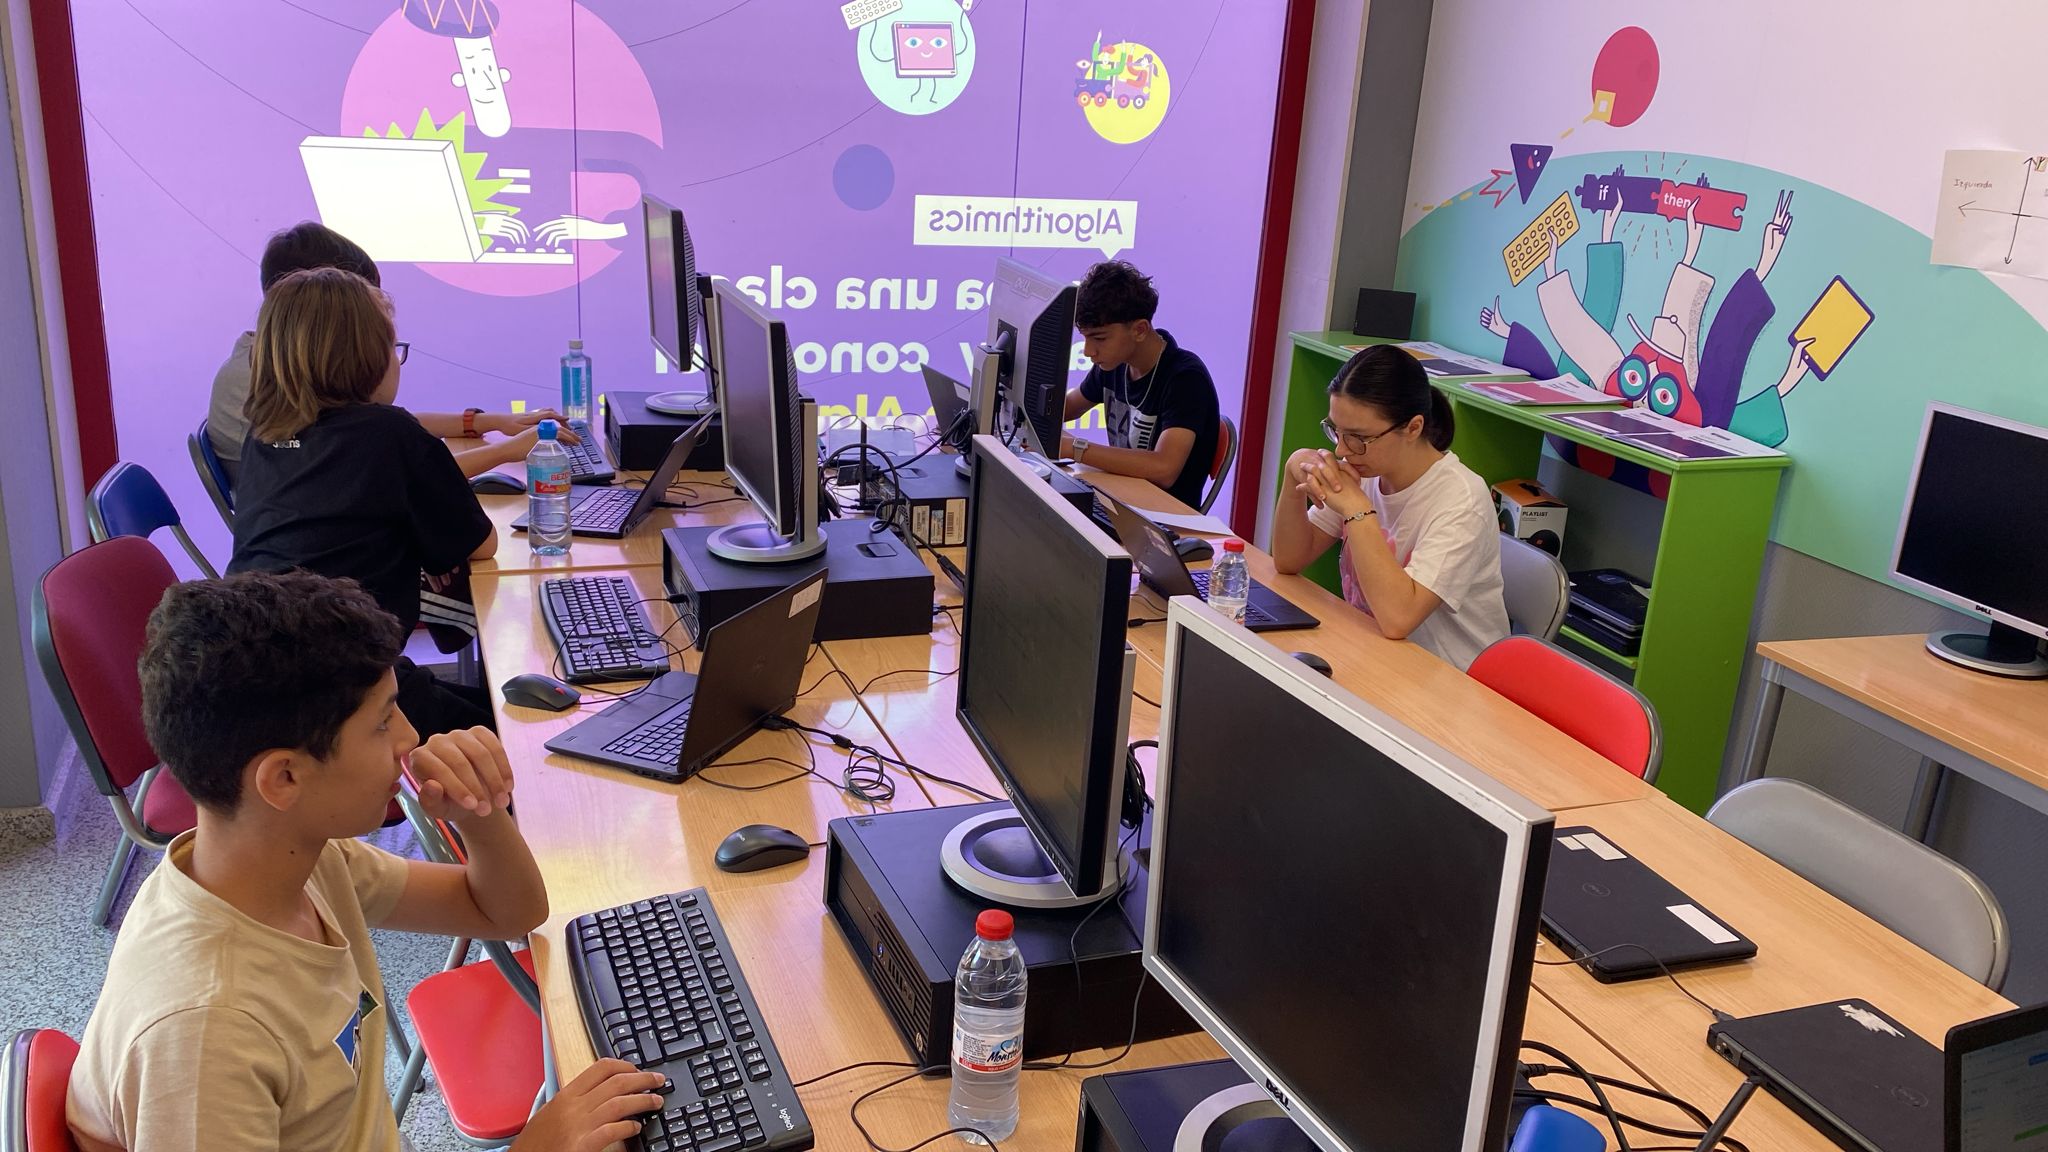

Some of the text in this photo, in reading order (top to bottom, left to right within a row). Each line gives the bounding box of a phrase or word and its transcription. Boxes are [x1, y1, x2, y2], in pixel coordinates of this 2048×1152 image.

[1599, 184, 1609, 201] if
[1664, 193, 1691, 209] then
[1975, 605, 1992, 616] DELL
[1266, 1078, 1291, 1111] DELL
[779, 1108, 795, 1131] logitech
